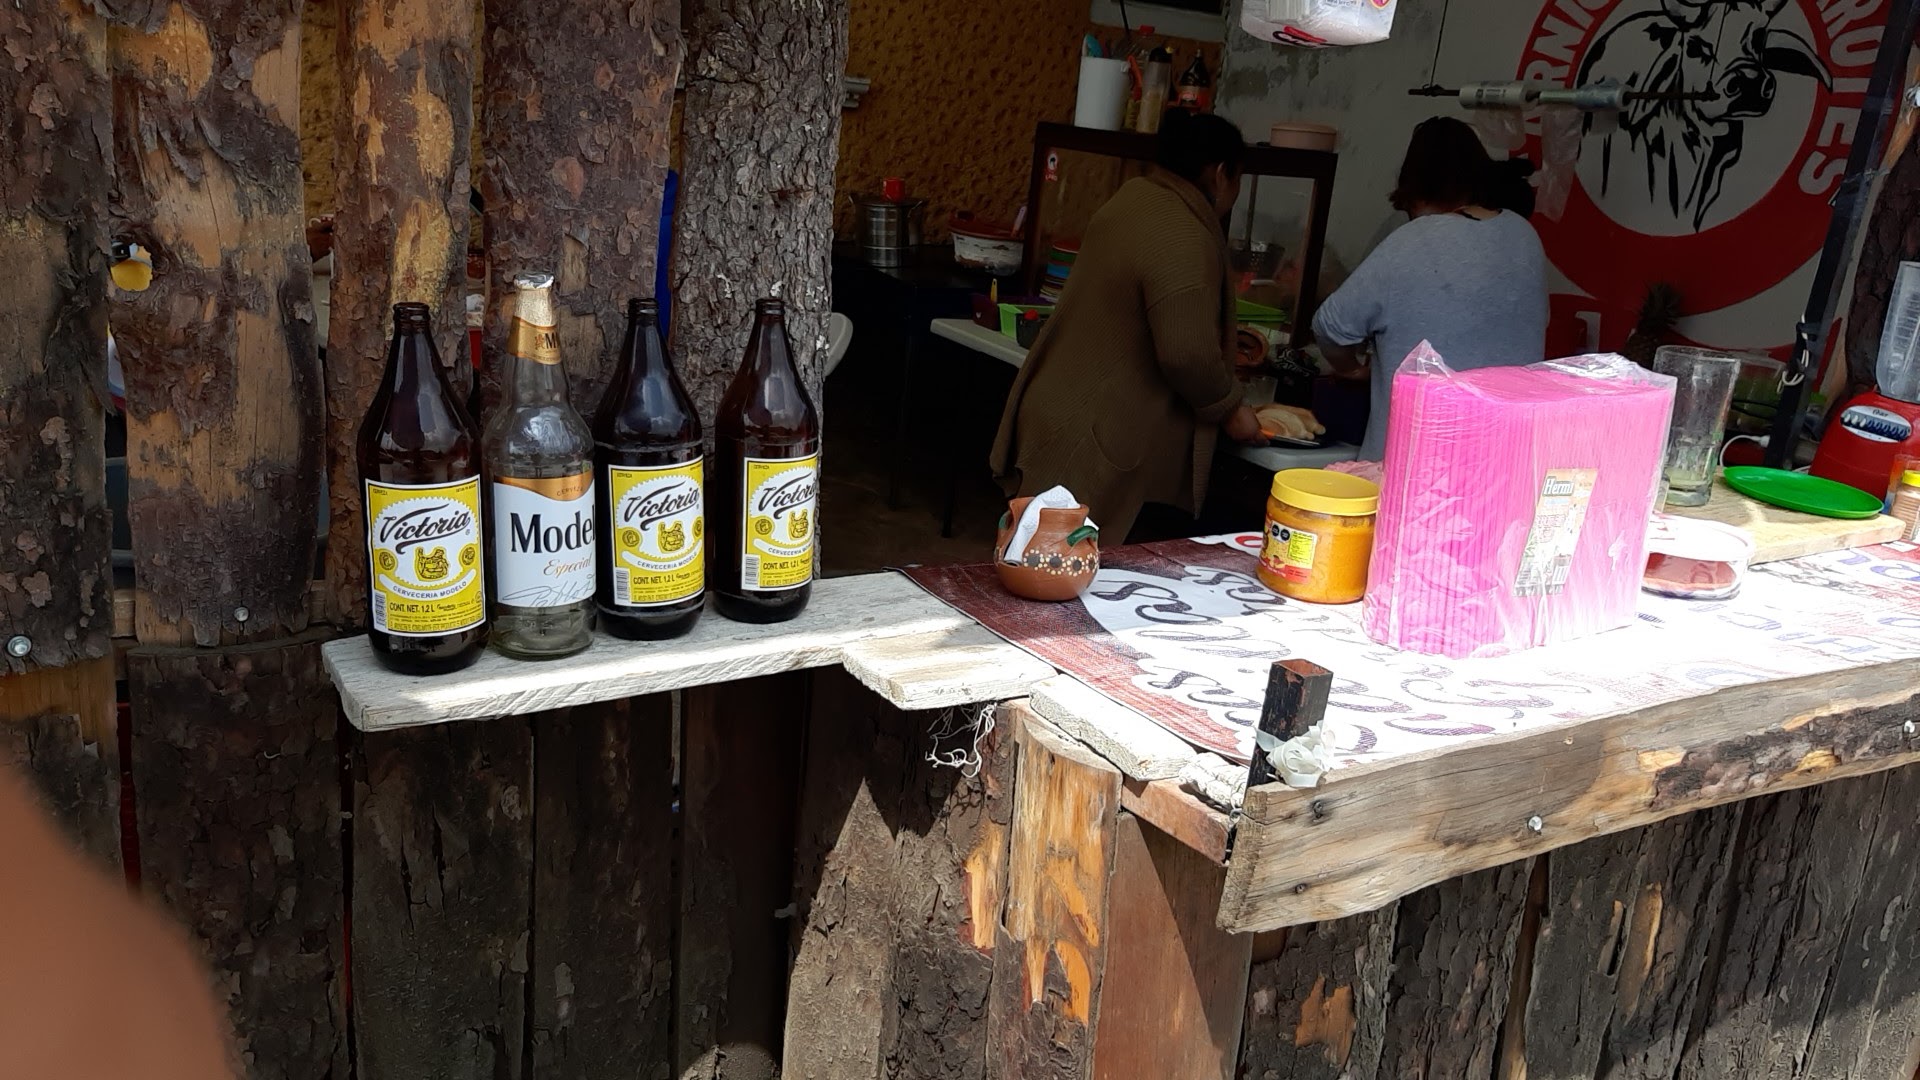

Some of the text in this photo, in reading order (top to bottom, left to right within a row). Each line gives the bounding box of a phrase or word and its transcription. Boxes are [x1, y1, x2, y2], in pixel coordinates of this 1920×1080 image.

[623, 480, 700, 532] Victoria
[758, 470, 817, 520] Victori
[379, 503, 471, 555] Victoria
[543, 552, 593, 579] Especial
[637, 561, 678, 571] CERVECERIA
[393, 580, 468, 599] CERVECERIA MODELO
